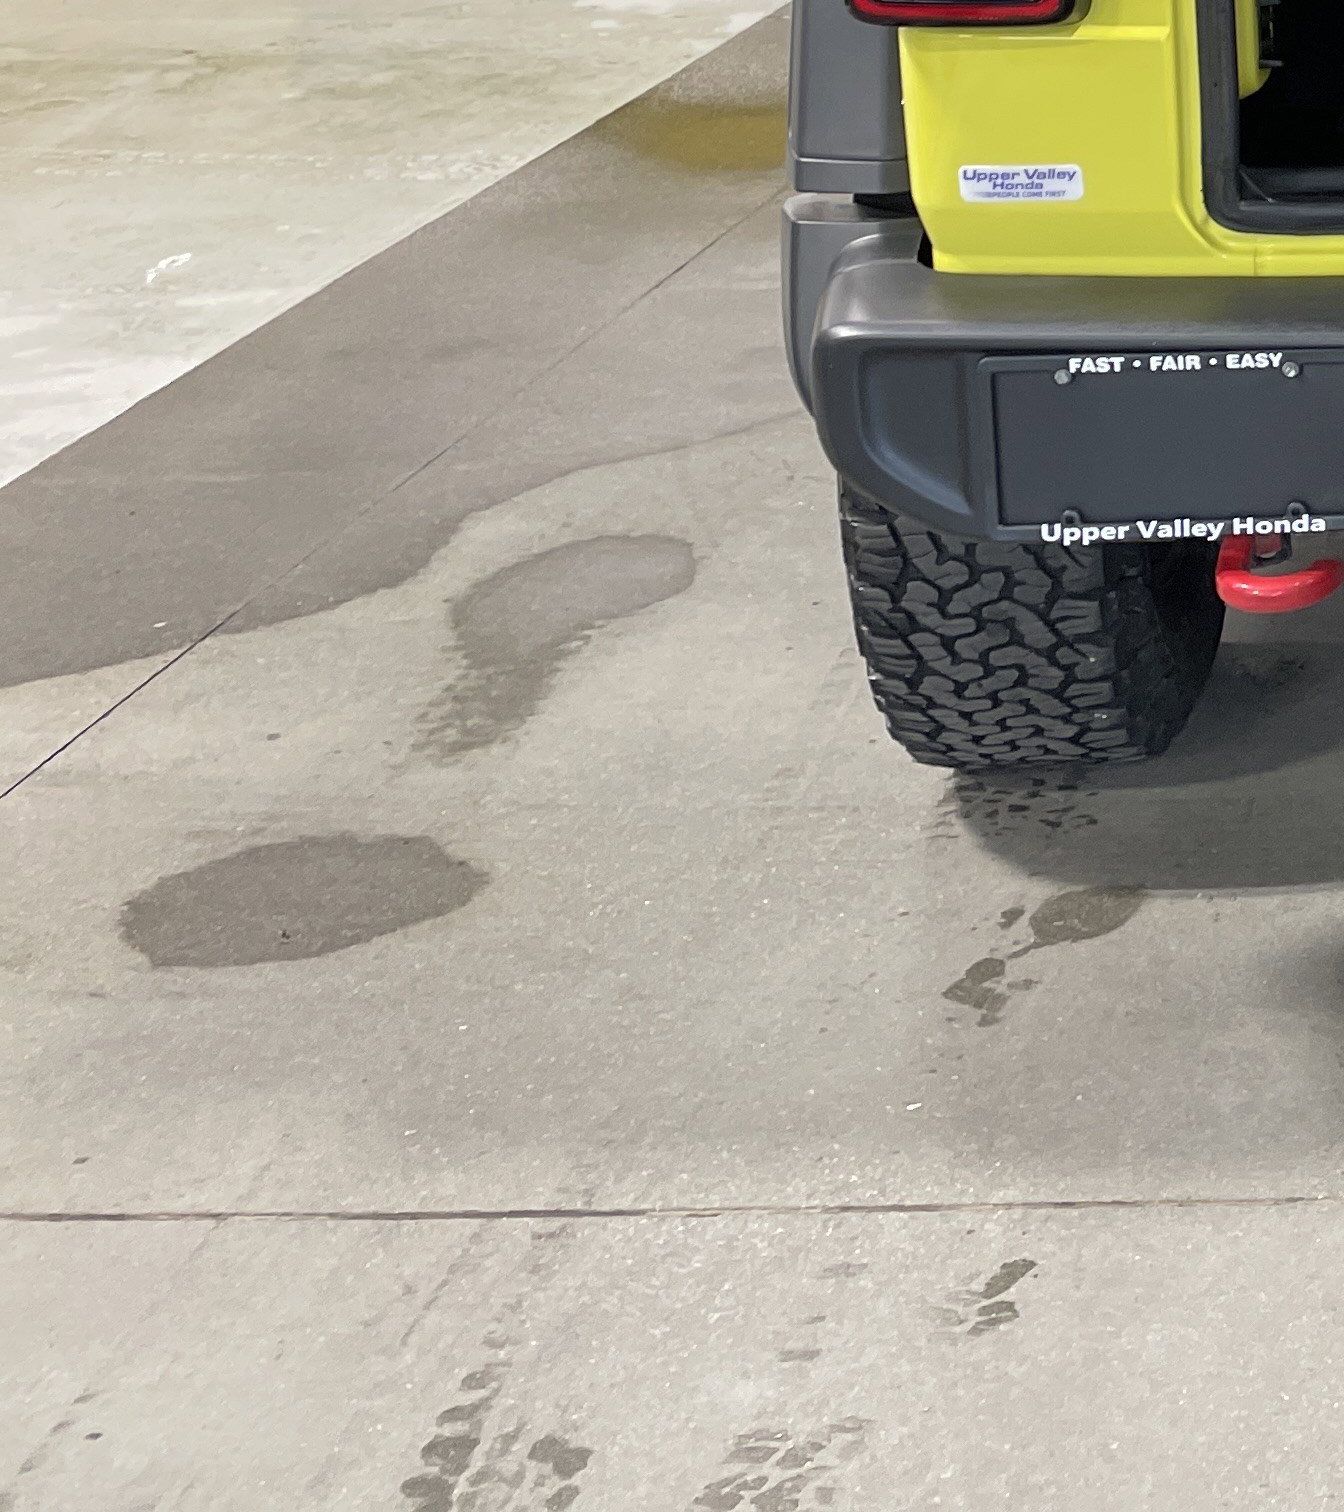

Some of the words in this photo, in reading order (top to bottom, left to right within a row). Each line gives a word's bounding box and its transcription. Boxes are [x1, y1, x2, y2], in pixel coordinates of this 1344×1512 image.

[963, 169, 1021, 183] Upper
[1023, 168, 1077, 182] Valley
[992, 180, 1044, 190] Honda
[1068, 356, 1125, 374] FAST
[1149, 354, 1202, 372] FAIR
[1225, 352, 1283, 370] EASY
[1040, 522, 1130, 546] Upper
[1136, 518, 1225, 541] Valley
[1232, 514, 1326, 535] Honda
